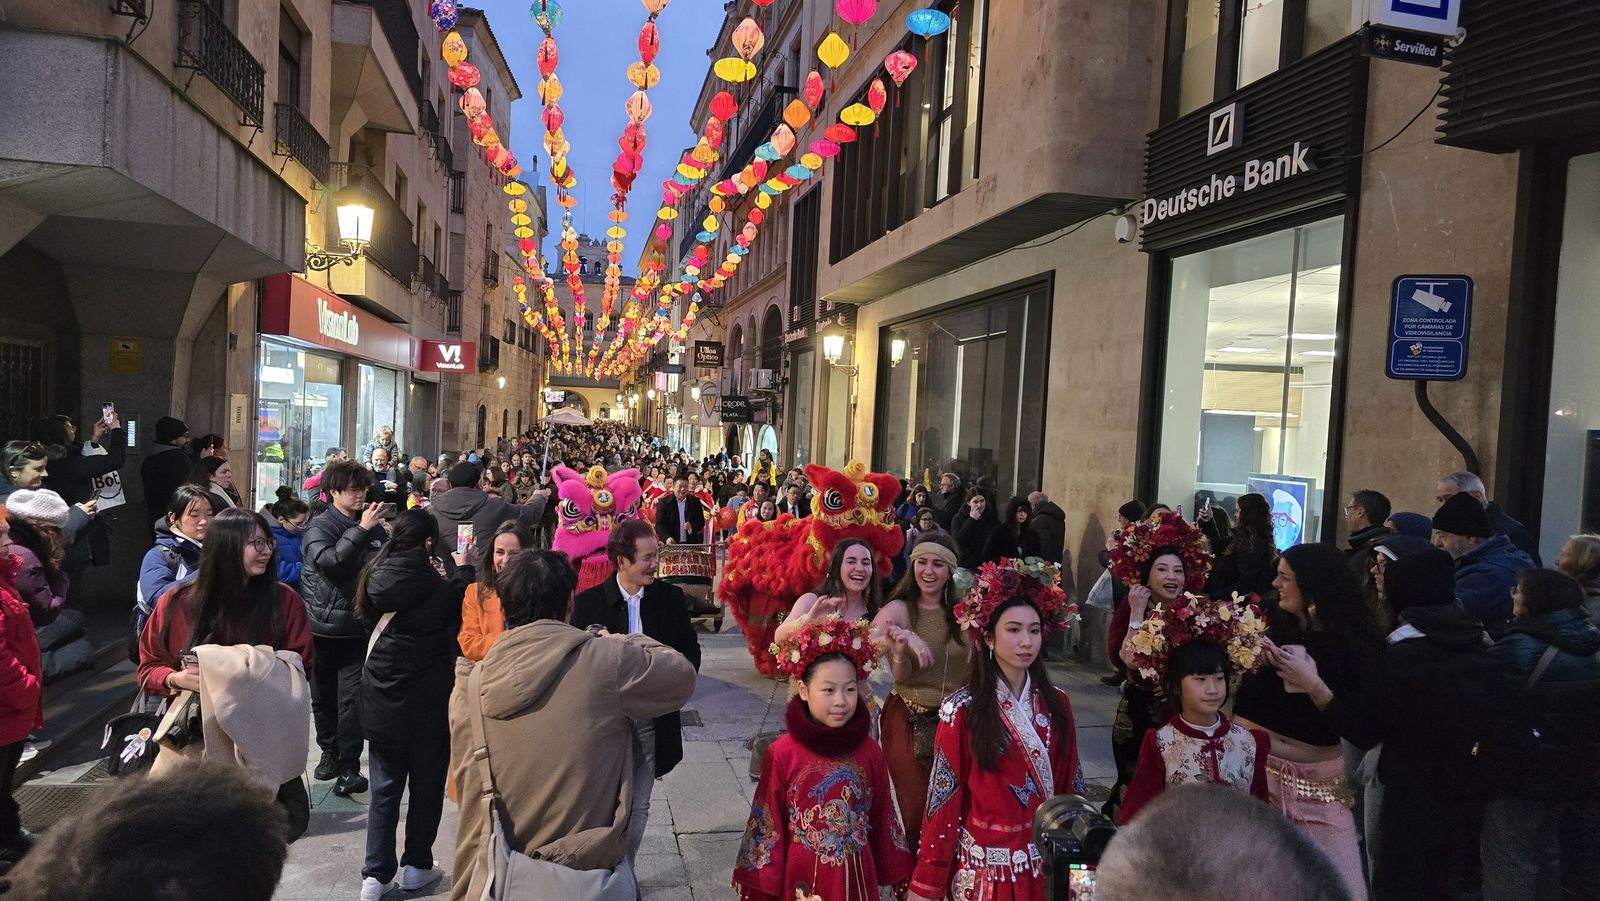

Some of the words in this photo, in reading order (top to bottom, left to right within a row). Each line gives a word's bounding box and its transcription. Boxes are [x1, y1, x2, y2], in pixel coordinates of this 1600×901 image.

[1394, 40, 1436, 56] ServiRed
[1143, 174, 1235, 226] Deutsche
[1243, 141, 1310, 192] Bank
[699, 346, 717, 354] Ulloa
